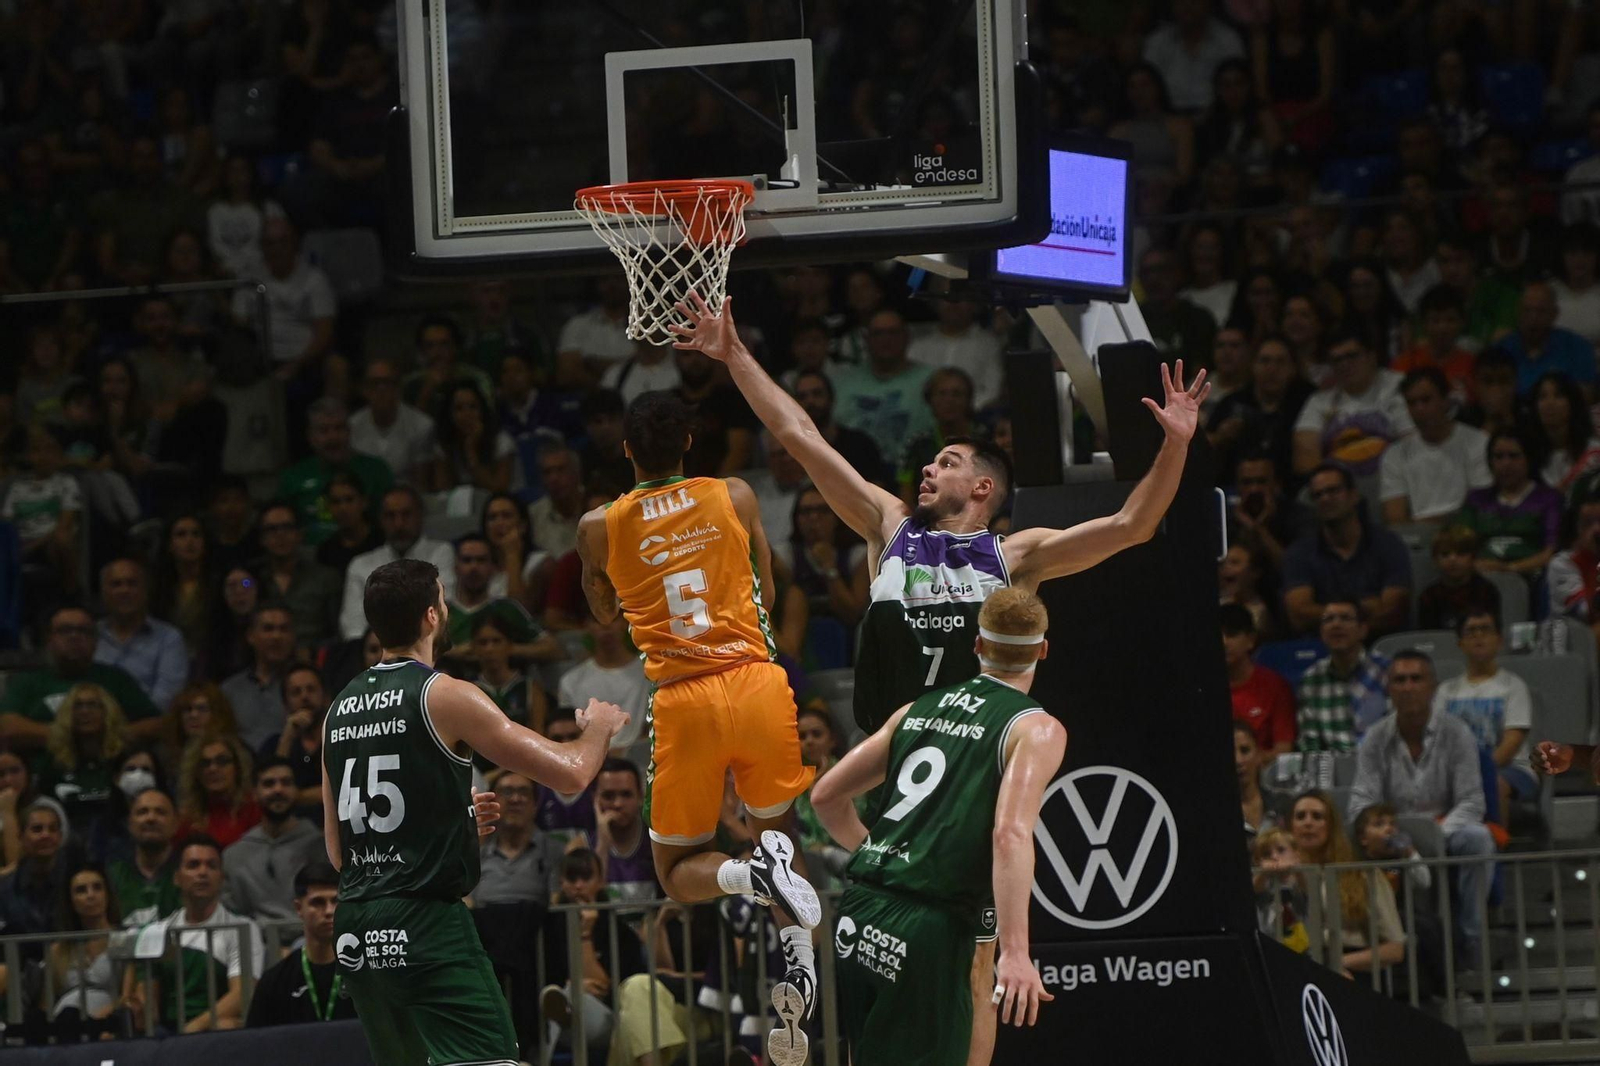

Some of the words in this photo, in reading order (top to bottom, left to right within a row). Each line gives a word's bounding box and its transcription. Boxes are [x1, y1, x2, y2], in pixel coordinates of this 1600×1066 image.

[914, 154, 943, 170] liga
[914, 168, 977, 183] endesa
[1051, 212, 1117, 247] daciónUnicaja
[640, 488, 698, 521] HILL
[671, 522, 719, 543] Andalucía
[673, 544, 706, 557] DEPORTE
[663, 568, 712, 640] 5
[922, 646, 944, 686] 7
[336, 689, 404, 716] KRAVISH
[938, 687, 986, 713] DÍAZ
[330, 717, 407, 743] BENAHAVÍS
[338, 754, 405, 834] 45
[883, 746, 946, 821] 9
[349, 845, 406, 866] Andalucía
[364, 929, 409, 944] COSTA
[862, 924, 907, 958] COSTA
[365, 946, 379, 958] DEL
[381, 944, 407, 956] SOL
[857, 940, 877, 959] DEL
[879, 951, 901, 971] SOL
[857, 953, 896, 983] MÁLAGA
[1034, 958, 1097, 991] laga
[1104, 956, 1211, 987] Wagen
